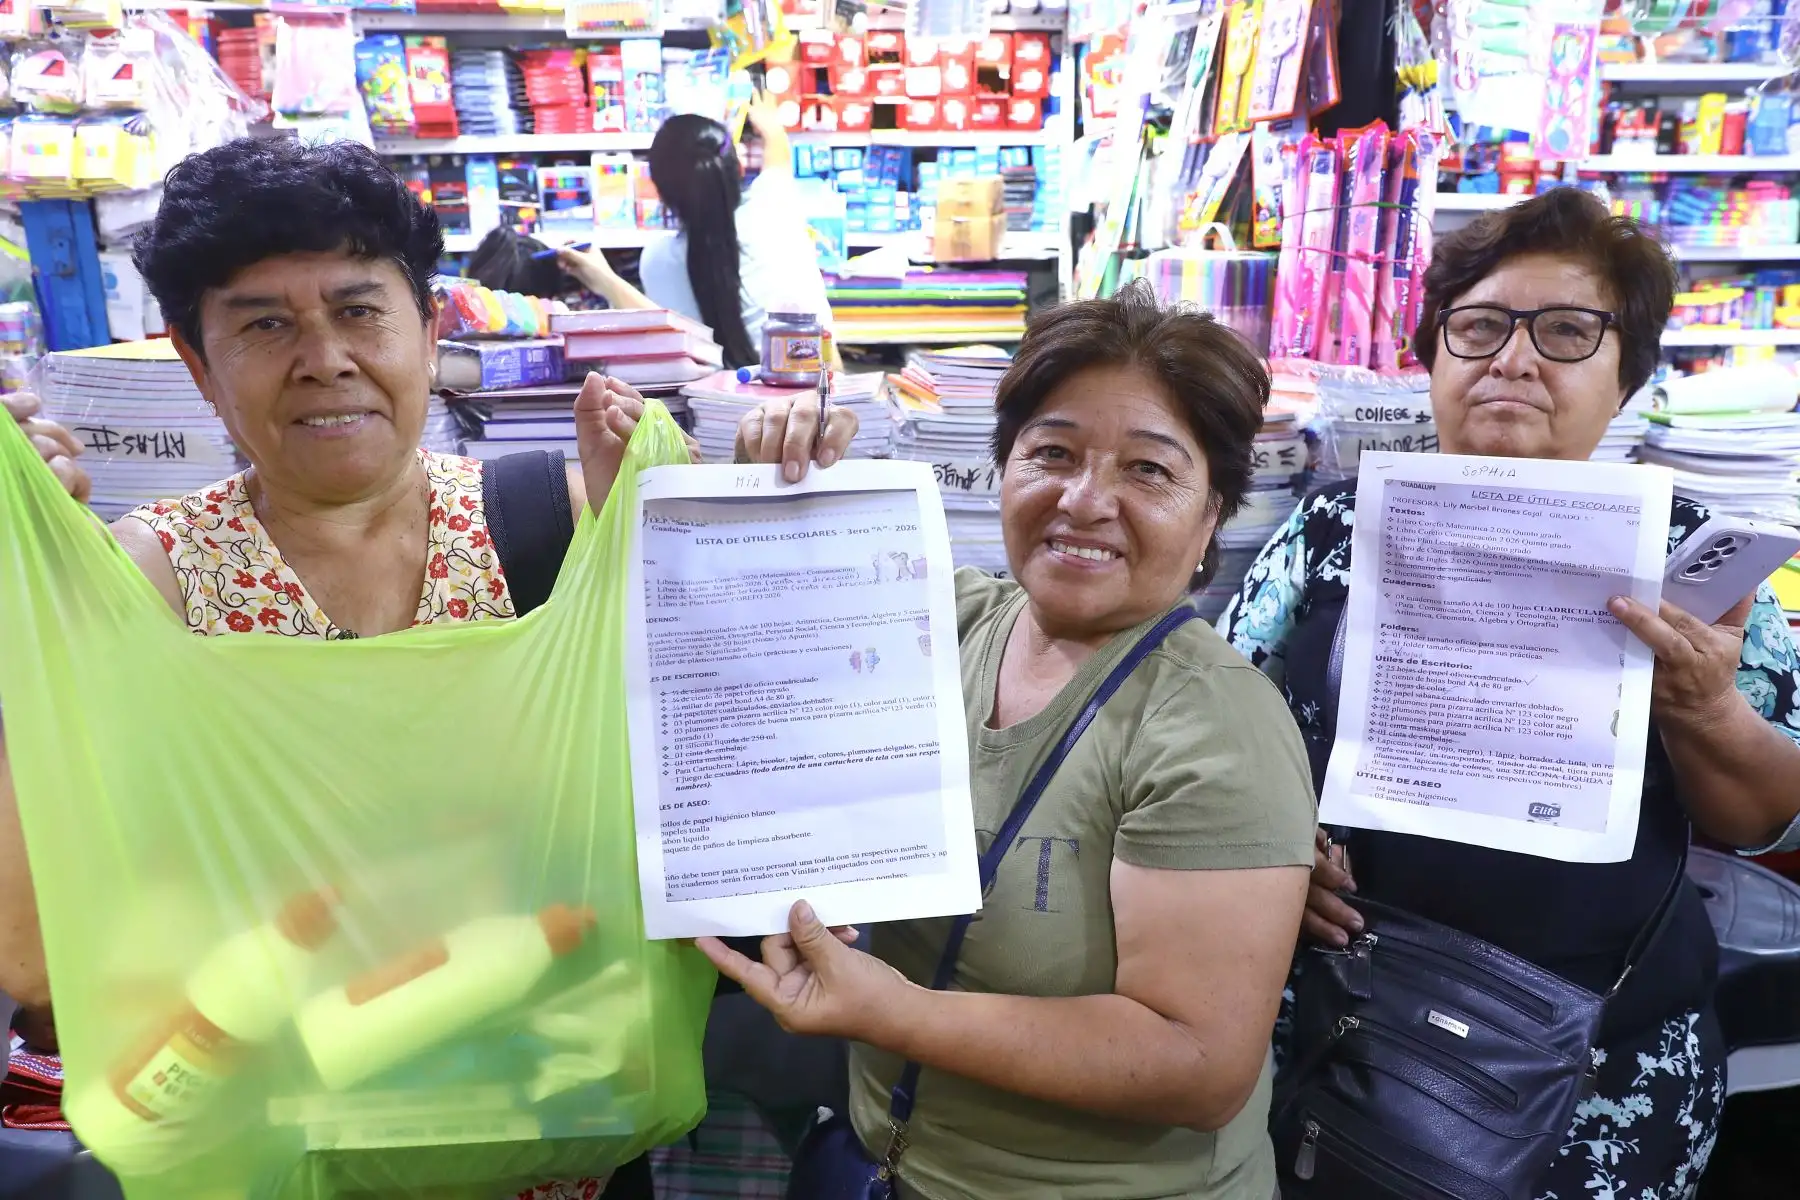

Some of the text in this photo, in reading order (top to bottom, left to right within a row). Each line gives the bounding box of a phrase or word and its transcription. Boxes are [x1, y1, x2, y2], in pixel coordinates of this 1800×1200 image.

[1400, 481, 1437, 491] GUADALUPE
[1443, 501, 1457, 509] Lily
[1459, 503, 1490, 512] Maribel
[1491, 506, 1521, 515] Briones
[1471, 490, 1641, 513] LISTA DE ÚTILES ESCOLARES
[1388, 506, 1425, 516] Textos:
[651, 525, 692, 534] Guadalupe
[695, 537, 724, 546] LISTA
[726, 537, 740, 545] DE
[743, 533, 778, 543] ÚTILES
[780, 529, 837, 541] ESCOLARES
[895, 524, 917, 532] 2026
[1396, 517, 1417, 526] Libro
[1512, 528, 1539, 537] Quinto
[1540, 531, 1562, 540] grado
[1521, 538, 1548, 547] Quinto
[1549, 540, 1572, 550] grado
[1382, 577, 1436, 589] Cuadernos:
[1406, 595, 1442, 605] cuadernos
[1512, 603, 1532, 611] hojas
[1475, 609, 1504, 617] Ciencia
[1561, 615, 1594, 624] Personal
[1380, 623, 1420, 633] Folders:
[1426, 643, 1453, 651] tamaño
[1454, 646, 1477, 654] oficio
[1406, 657, 1419, 665] de
[1421, 659, 1473, 670] Escritorio:
[674, 671, 720, 680] ESCRITORIO:
[714, 700, 733, 708] papel
[1491, 700, 1564, 713] enviarlos doblados
[684, 716, 719, 727] plumones
[720, 715, 736, 723] para
[737, 711, 761, 720] pizarra
[815, 704, 833, 712] color
[1393, 698, 1428, 708] plumones
[1447, 703, 1474, 712] pizarra
[1533, 713, 1555, 721] color
[1556, 715, 1579, 724] negro
[1518, 727, 1532, 735] 123
[1533, 730, 1555, 738] color
[1556, 732, 1573, 740] rojo
[1396, 777, 1410, 785] DE
[1412, 779, 1442, 789] ASEO
[1497, 774, 1582, 790] respectivos nombres)
[1387, 788, 1416, 797] papeles
[686, 799, 711, 808] ASEO:
[1408, 799, 1430, 807] toalla
[693, 816, 713, 825] papel
[751, 809, 776, 817] blanco
[1531, 805, 1558, 817] Elite
[689, 825, 710, 834] toalla
[703, 842, 725, 851] paños
[737, 836, 770, 846] limpieza
[681, 872, 699, 880] debe
[701, 870, 721, 878] tener
[722, 868, 739, 876] para
[766, 860, 798, 871] personal
[799, 859, 813, 867] una
[814, 855, 835, 864] toalla
[861, 848, 899, 859] respectivo
[900, 844, 928, 853] nombre
[680, 878, 719, 889] cuadernos
[720, 875, 741, 884] serán
[742, 872, 774, 882] forrados
[827, 859, 869, 871] etiquetados
[899, 851, 931, 862] nombres
[1015, 836, 1080, 912] T
